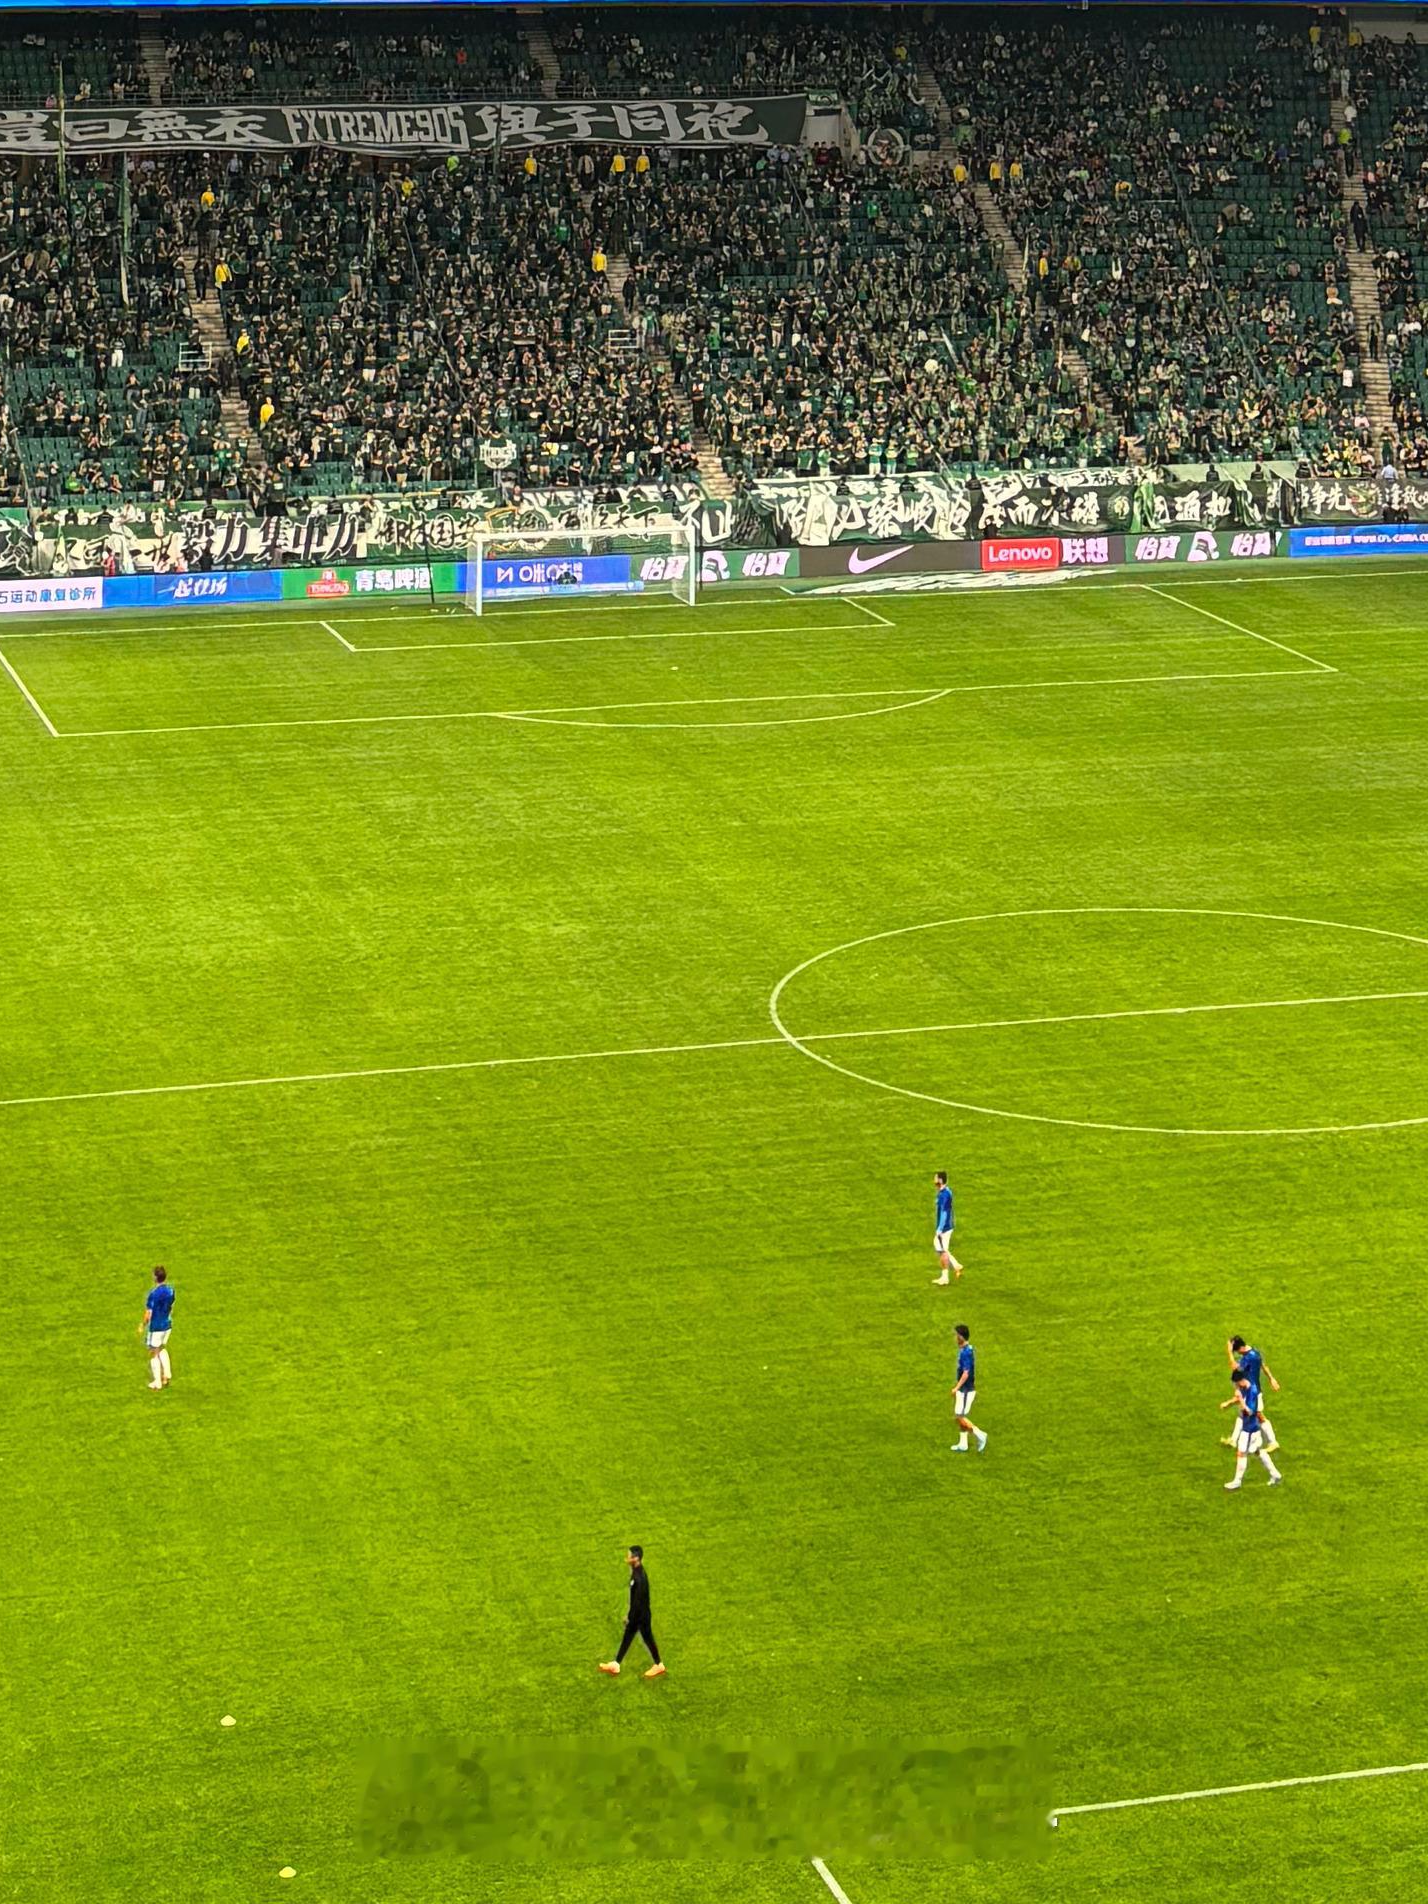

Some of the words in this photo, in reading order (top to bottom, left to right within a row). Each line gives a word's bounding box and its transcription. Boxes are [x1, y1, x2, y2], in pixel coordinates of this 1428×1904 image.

[988, 545, 1052, 562] Lenovo
[1062, 537, 1109, 563] 联想
[355, 568, 432, 591] 青岛啤酒
